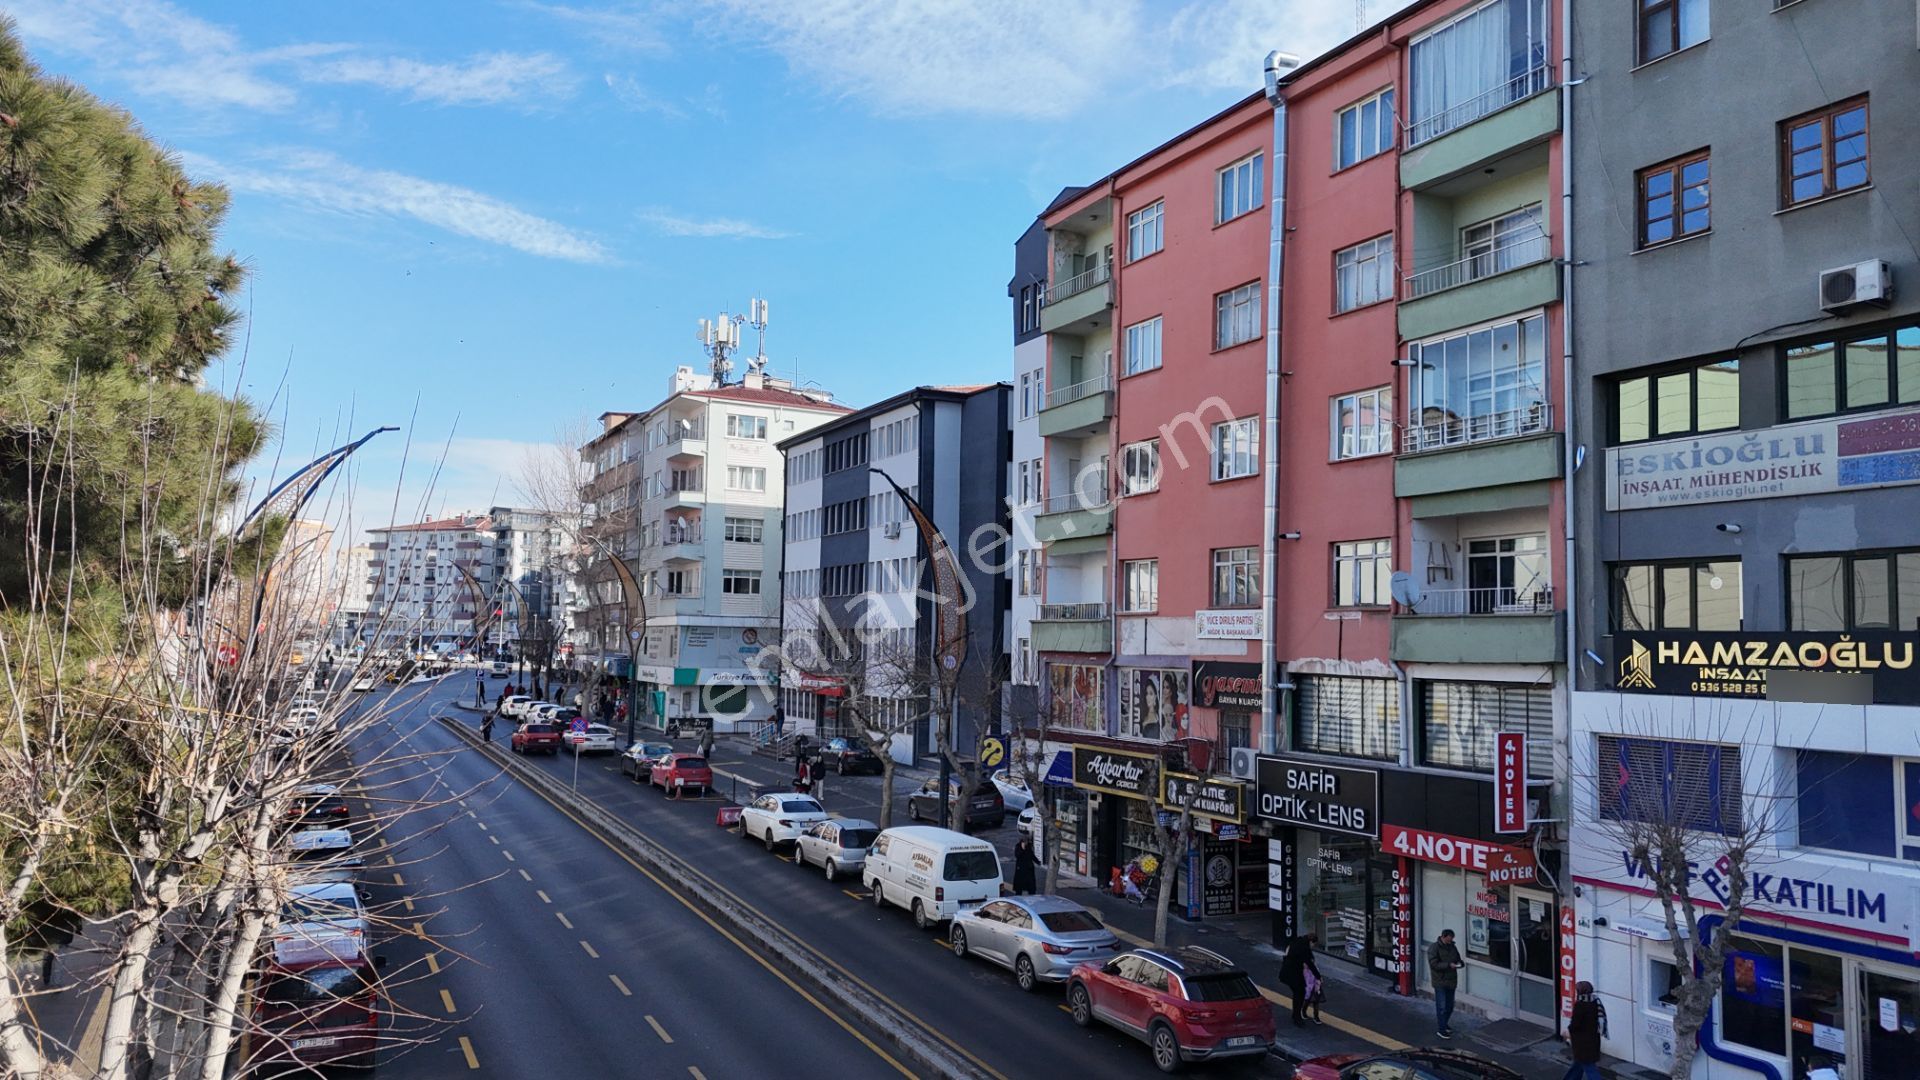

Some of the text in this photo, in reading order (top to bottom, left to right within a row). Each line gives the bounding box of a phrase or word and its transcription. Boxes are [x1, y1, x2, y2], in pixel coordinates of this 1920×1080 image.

[1615, 433, 1826, 476] ESKİOĞLU
[1690, 460, 1823, 488] MÜHENDİSLİK
[1658, 483, 1784, 502] www.eskioglu.net
[1658, 635, 1914, 669] HAMZAOĞLU
[1722, 683, 1742, 693] 528
[1745, 684, 1758, 694] 25
[1087, 755, 1143, 785] Aybarlar
[1287, 769, 1335, 795] SAFİR
[1318, 848, 1340, 860] SAFİR
[1394, 831, 1504, 869] 4.NOTE
[1490, 866, 1533, 882] NOTER
[1753, 872, 1886, 923] KATILIM
[1391, 870, 1400, 973] GÖZLÜKÇÜ
